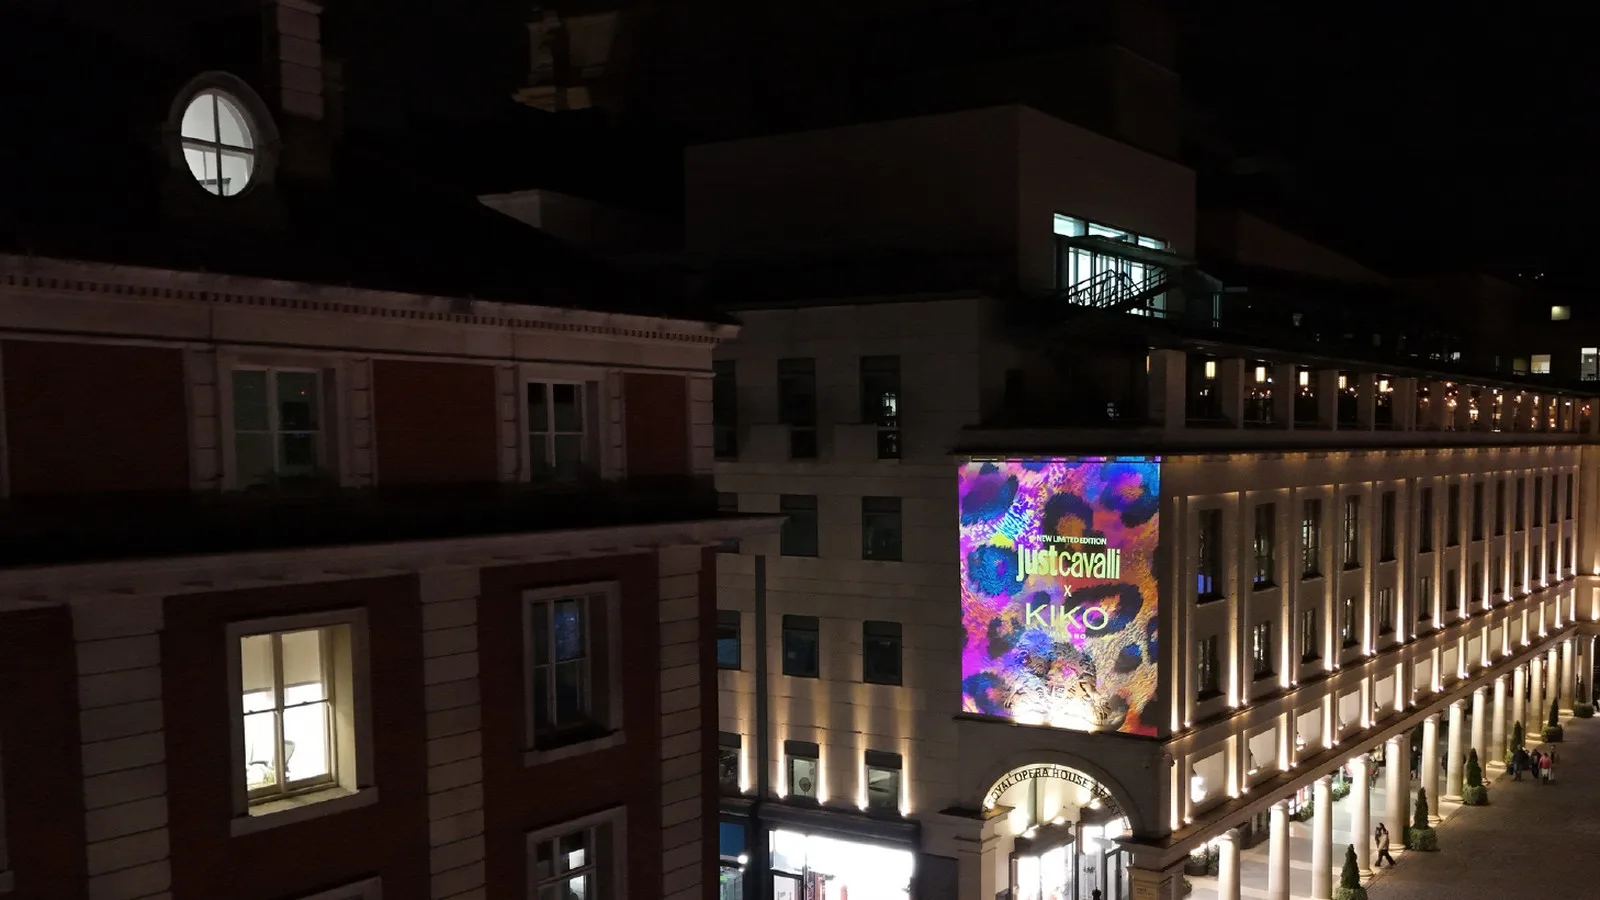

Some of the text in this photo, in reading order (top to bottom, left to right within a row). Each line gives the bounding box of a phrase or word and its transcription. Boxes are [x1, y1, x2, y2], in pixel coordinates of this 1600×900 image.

[1037, 535, 1107, 546] NEW LIMITED EDITION
[1025, 603, 1109, 630] KIKO
[1015, 768, 1049, 782] OPERA
[1053, 768, 1089, 788] HOUSE
